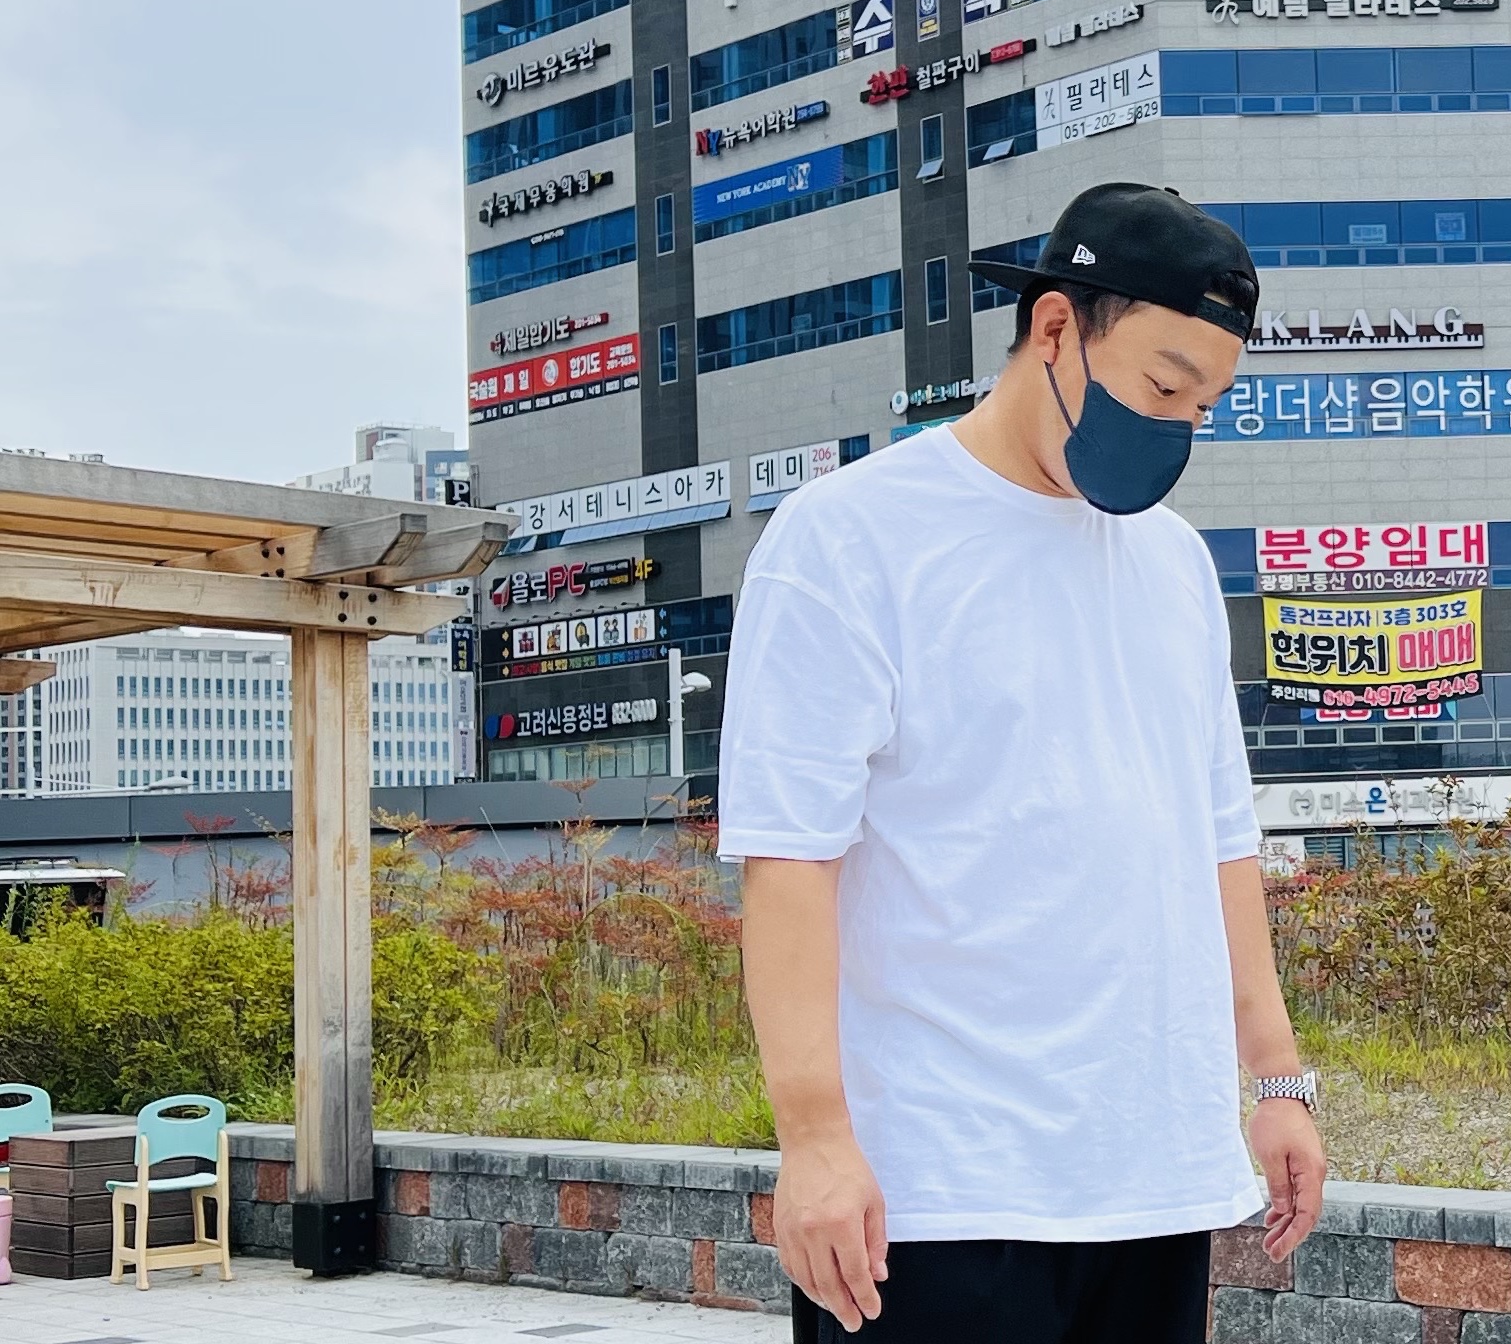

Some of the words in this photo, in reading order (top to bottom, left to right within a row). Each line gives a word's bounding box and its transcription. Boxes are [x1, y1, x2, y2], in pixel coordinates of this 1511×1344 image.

[507, 38, 596, 91] 미르유도관
[916, 51, 980, 90] 철판구이
[1067, 63, 1156, 112] 필라테스
[722, 105, 797, 149] 뉴욕어학원
[1064, 101, 1159, 139] 051-202-5829
[502, 316, 571, 352] 제일합기도
[1261, 307, 1464, 339] KLANG
[569, 352, 601, 380] 합기도
[1260, 524, 1485, 571] 분양임대
[511, 561, 586, 604] 욜로PC
[634, 558, 654, 581] 4F
[1260, 572, 1347, 592] 광명부동산
[1352, 568, 1489, 590] 010-8442-4772
[1280, 605, 1372, 628] 동건프라자
[1383, 610, 1411, 626] 3층
[1416, 599, 1468, 624] 303호
[1270, 629, 1389, 675] 현위치
[1396, 621, 1476, 672] 매매
[1322, 673, 1480, 707] 010-4972-5445
[487, 703, 609, 737] 고려신용정보
[1320, 786, 1474, 816] 미소온과원
